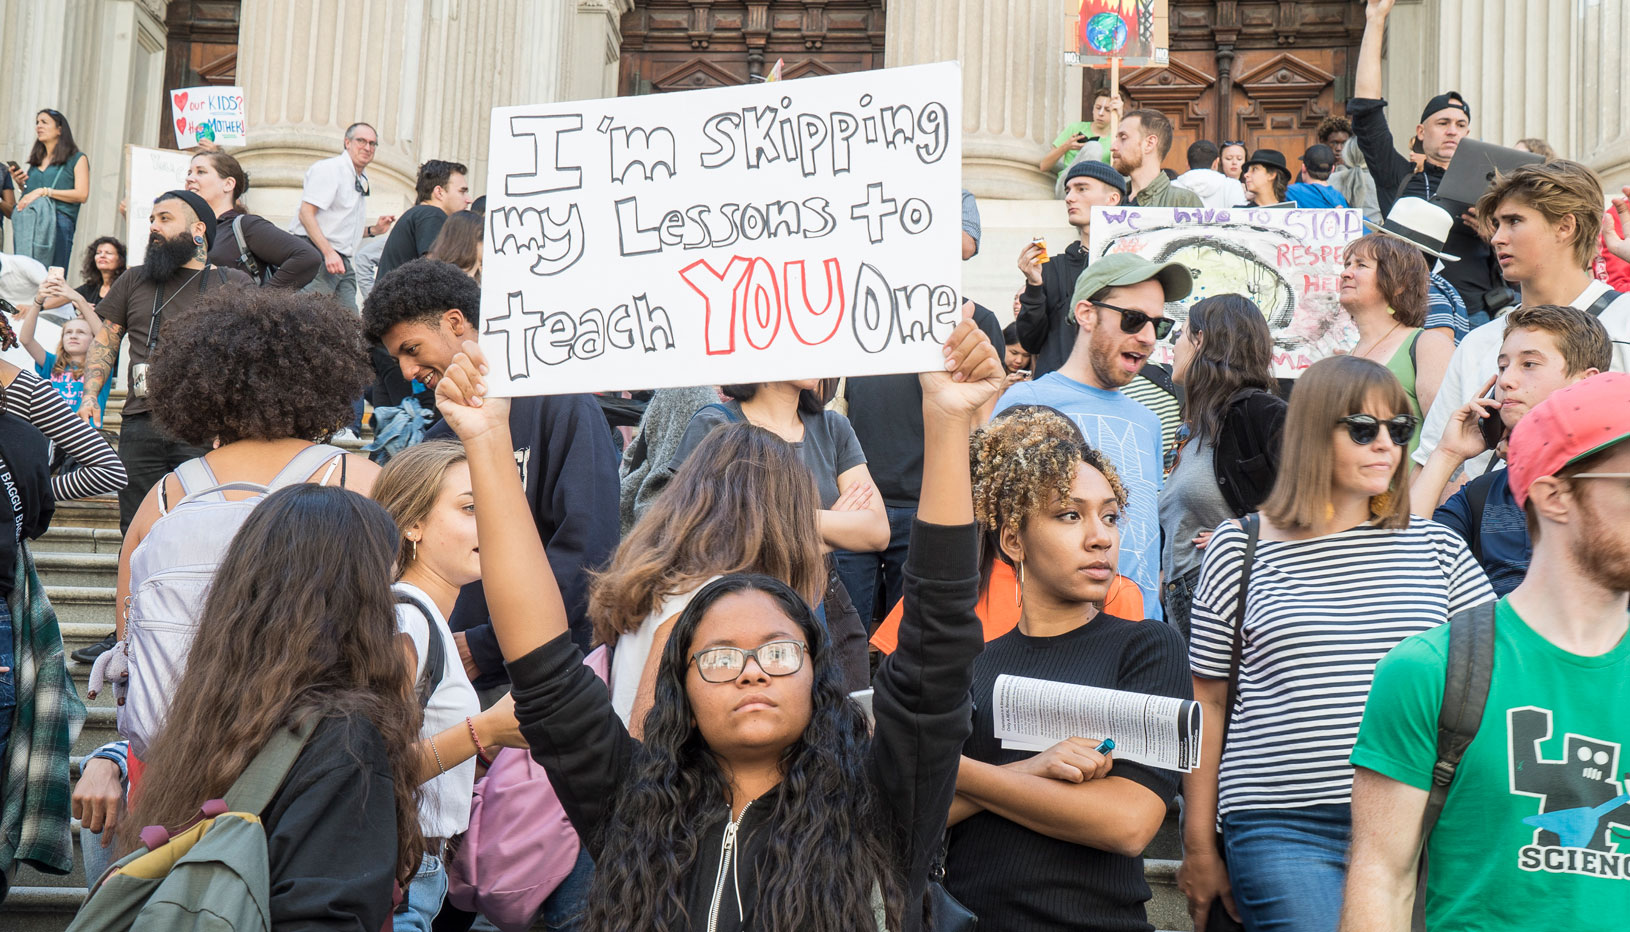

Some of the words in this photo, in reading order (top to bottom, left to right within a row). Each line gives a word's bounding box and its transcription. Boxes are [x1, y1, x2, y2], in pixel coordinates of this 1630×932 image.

[189, 101, 206, 112] our
[208, 95, 243, 115] KIDS?
[207, 117, 245, 137] MOTHER!
[505, 114, 677, 197] I'm
[489, 202, 585, 277] my
[615, 195, 837, 257] Lessons
[850, 181, 933, 245] to
[1284, 209, 1363, 242] STOP
[1276, 243, 1345, 268] RESPE
[483, 290, 676, 382] teach
[677, 254, 846, 356] YOU
[851, 261, 958, 354] One
[1, 472, 23, 512] BAGGU
